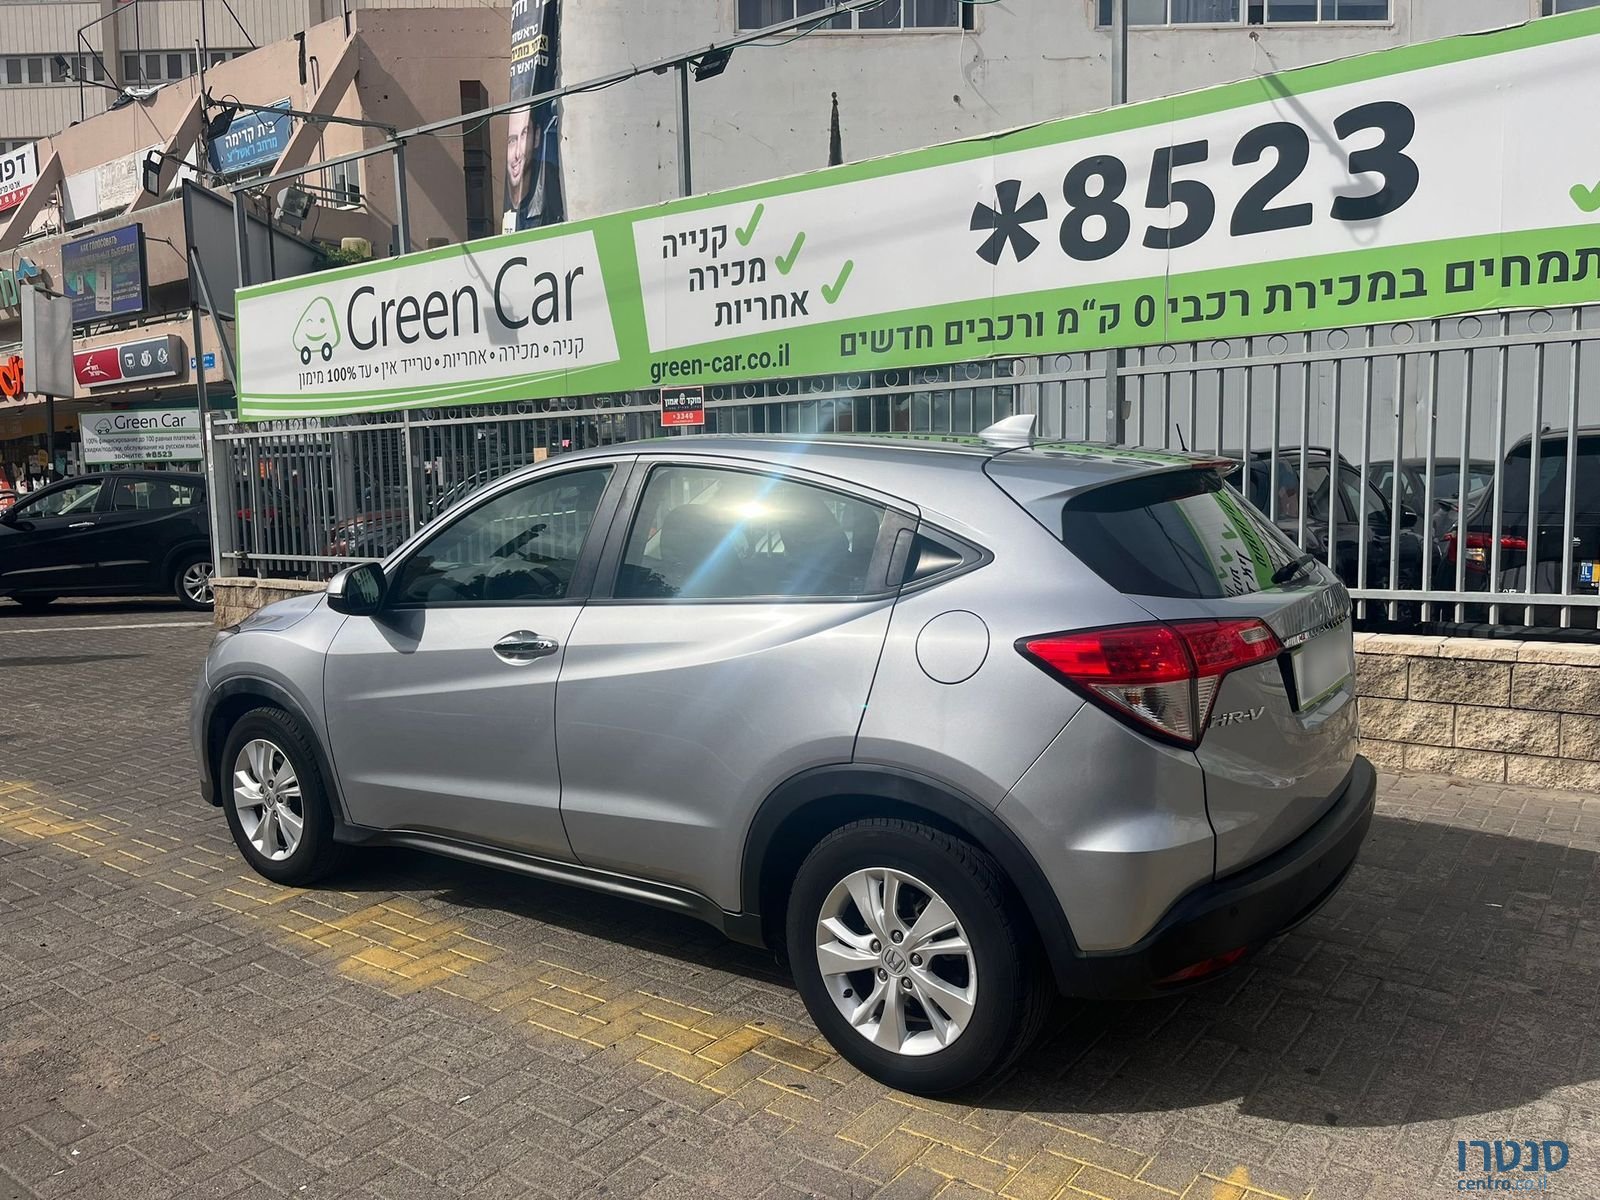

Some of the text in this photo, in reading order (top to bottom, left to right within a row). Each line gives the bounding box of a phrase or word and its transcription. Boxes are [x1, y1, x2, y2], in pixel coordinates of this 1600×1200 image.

[257, 120, 276, 138] בית
[662, 224, 728, 259] קנייה
[689, 257, 766, 292] מכירה
[1264, 267, 1428, 315] במכירת
[347, 256, 584, 351] Green Car
[715, 290, 809, 327] אחריות
[1134, 294, 1156, 328] 0
[1168, 289, 1250, 324] רכבי
[840, 325, 933, 357] חדשים
[945, 311, 1044, 346] ורכבים
[298, 336, 584, 389] קניה מכירה אחריות טרייד אין עד 100% מימון
[650, 343, 790, 384] green-car.co.il
[114, 413, 186, 430] Green Car
[1581, 565, 1590, 576] IL
[1209, 706, 1265, 729] HR-V
